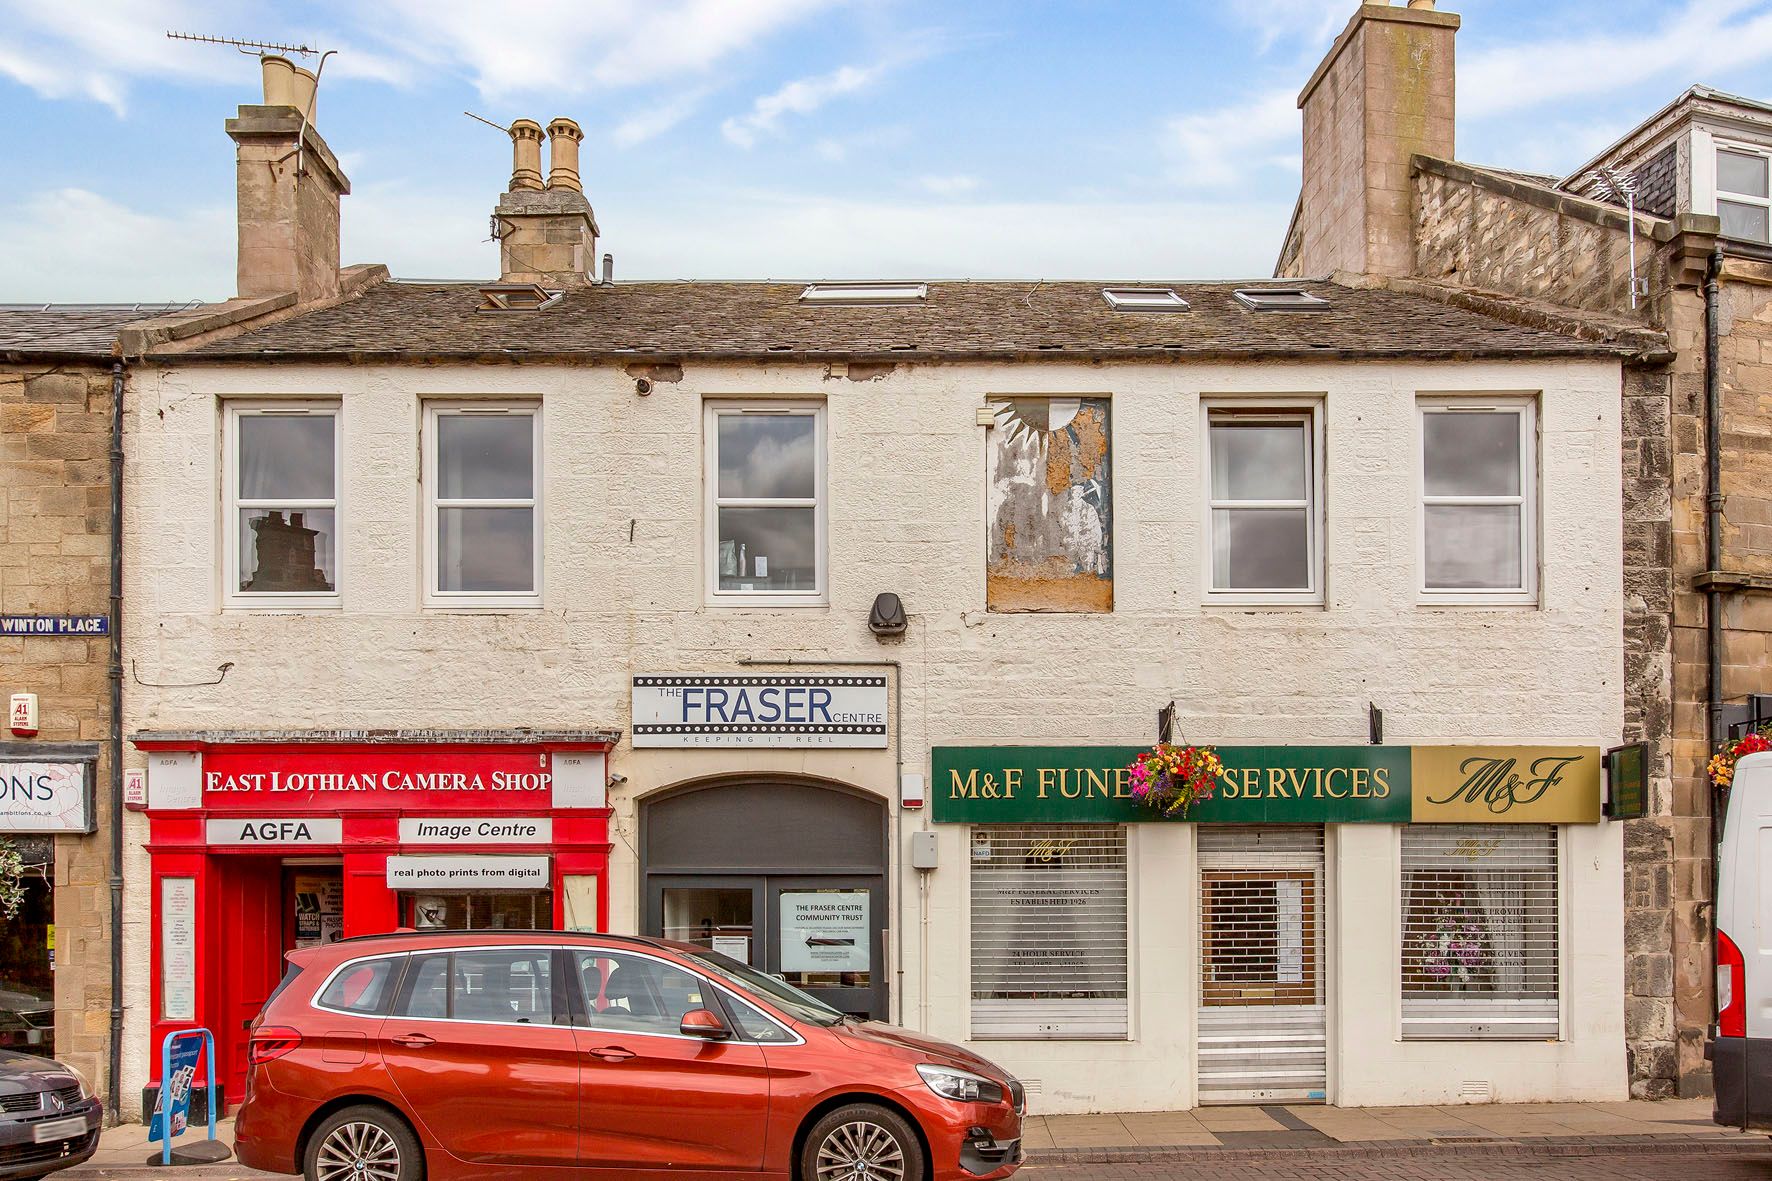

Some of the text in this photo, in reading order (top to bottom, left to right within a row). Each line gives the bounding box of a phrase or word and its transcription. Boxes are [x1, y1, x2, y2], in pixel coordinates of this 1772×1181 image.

[2, 619, 53, 632] WINTON
[15, 703, 28, 715] A1
[658, 688, 882, 723] THE FRASER CENTRE
[206, 770, 552, 792] EAST LOTHIAN CAMERA SHOP
[949, 768, 1023, 799] M&F
[1222, 768, 1390, 799] SERVICES
[1426, 755, 1585, 814] M&F
[239, 822, 313, 841] AGFA
[417, 822, 536, 838] Image Centre
[394, 868, 541, 880] real photo prints from digital
[299, 912, 320, 921] WATCH
